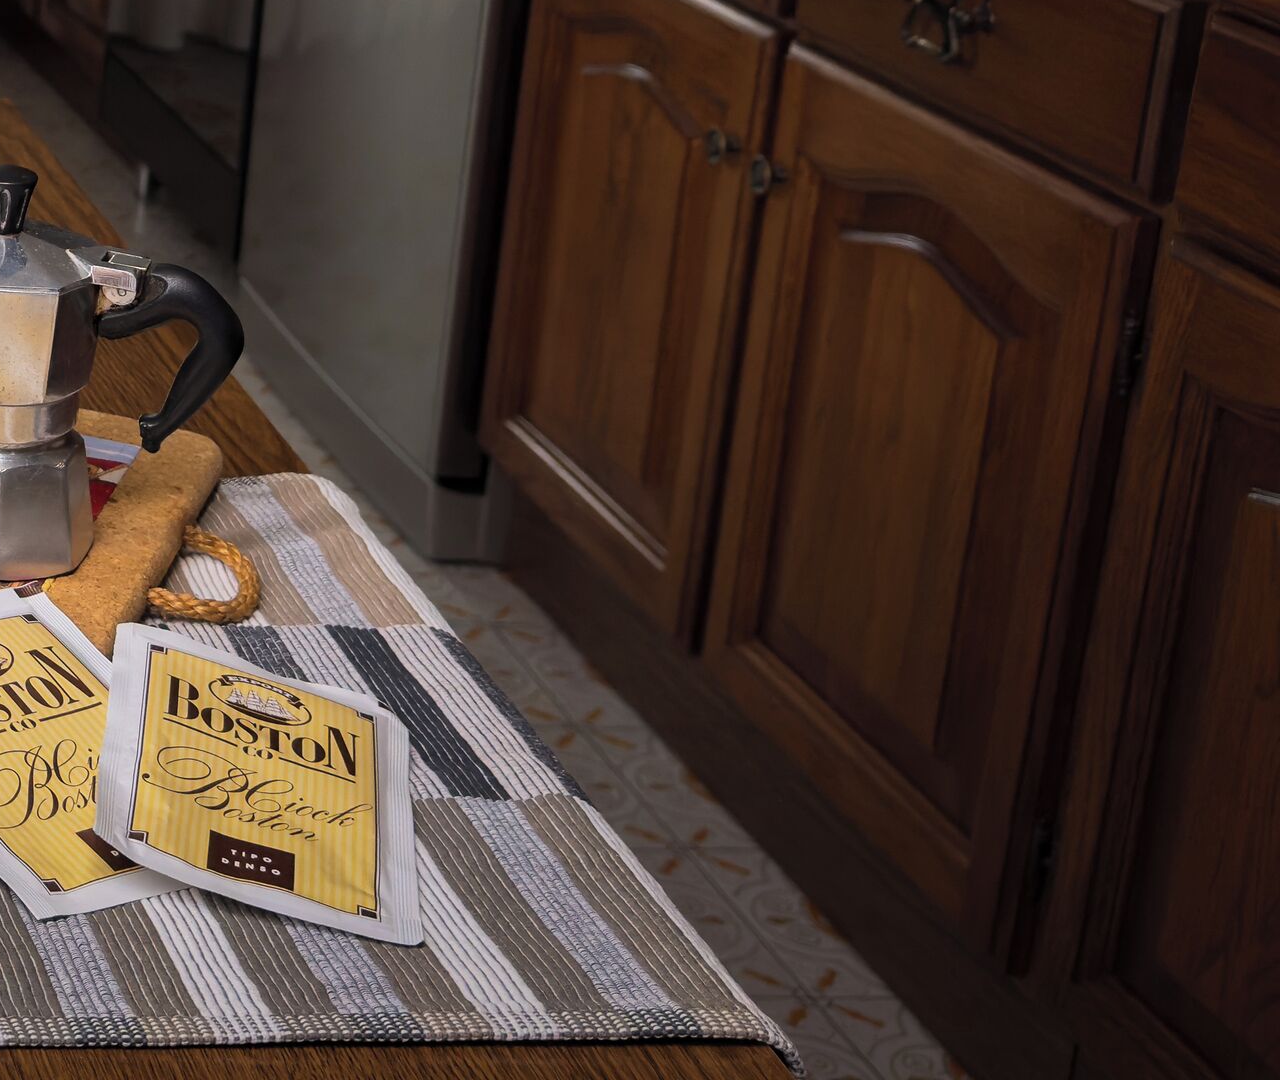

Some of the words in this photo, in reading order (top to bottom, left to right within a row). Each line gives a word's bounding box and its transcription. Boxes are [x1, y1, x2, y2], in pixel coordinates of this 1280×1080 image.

[228, 675, 296, 701] EXPORT
[167, 673, 360, 777] BOSTON
[221, 857, 281, 876] DENSO
[230, 848, 272, 864] TIPO
